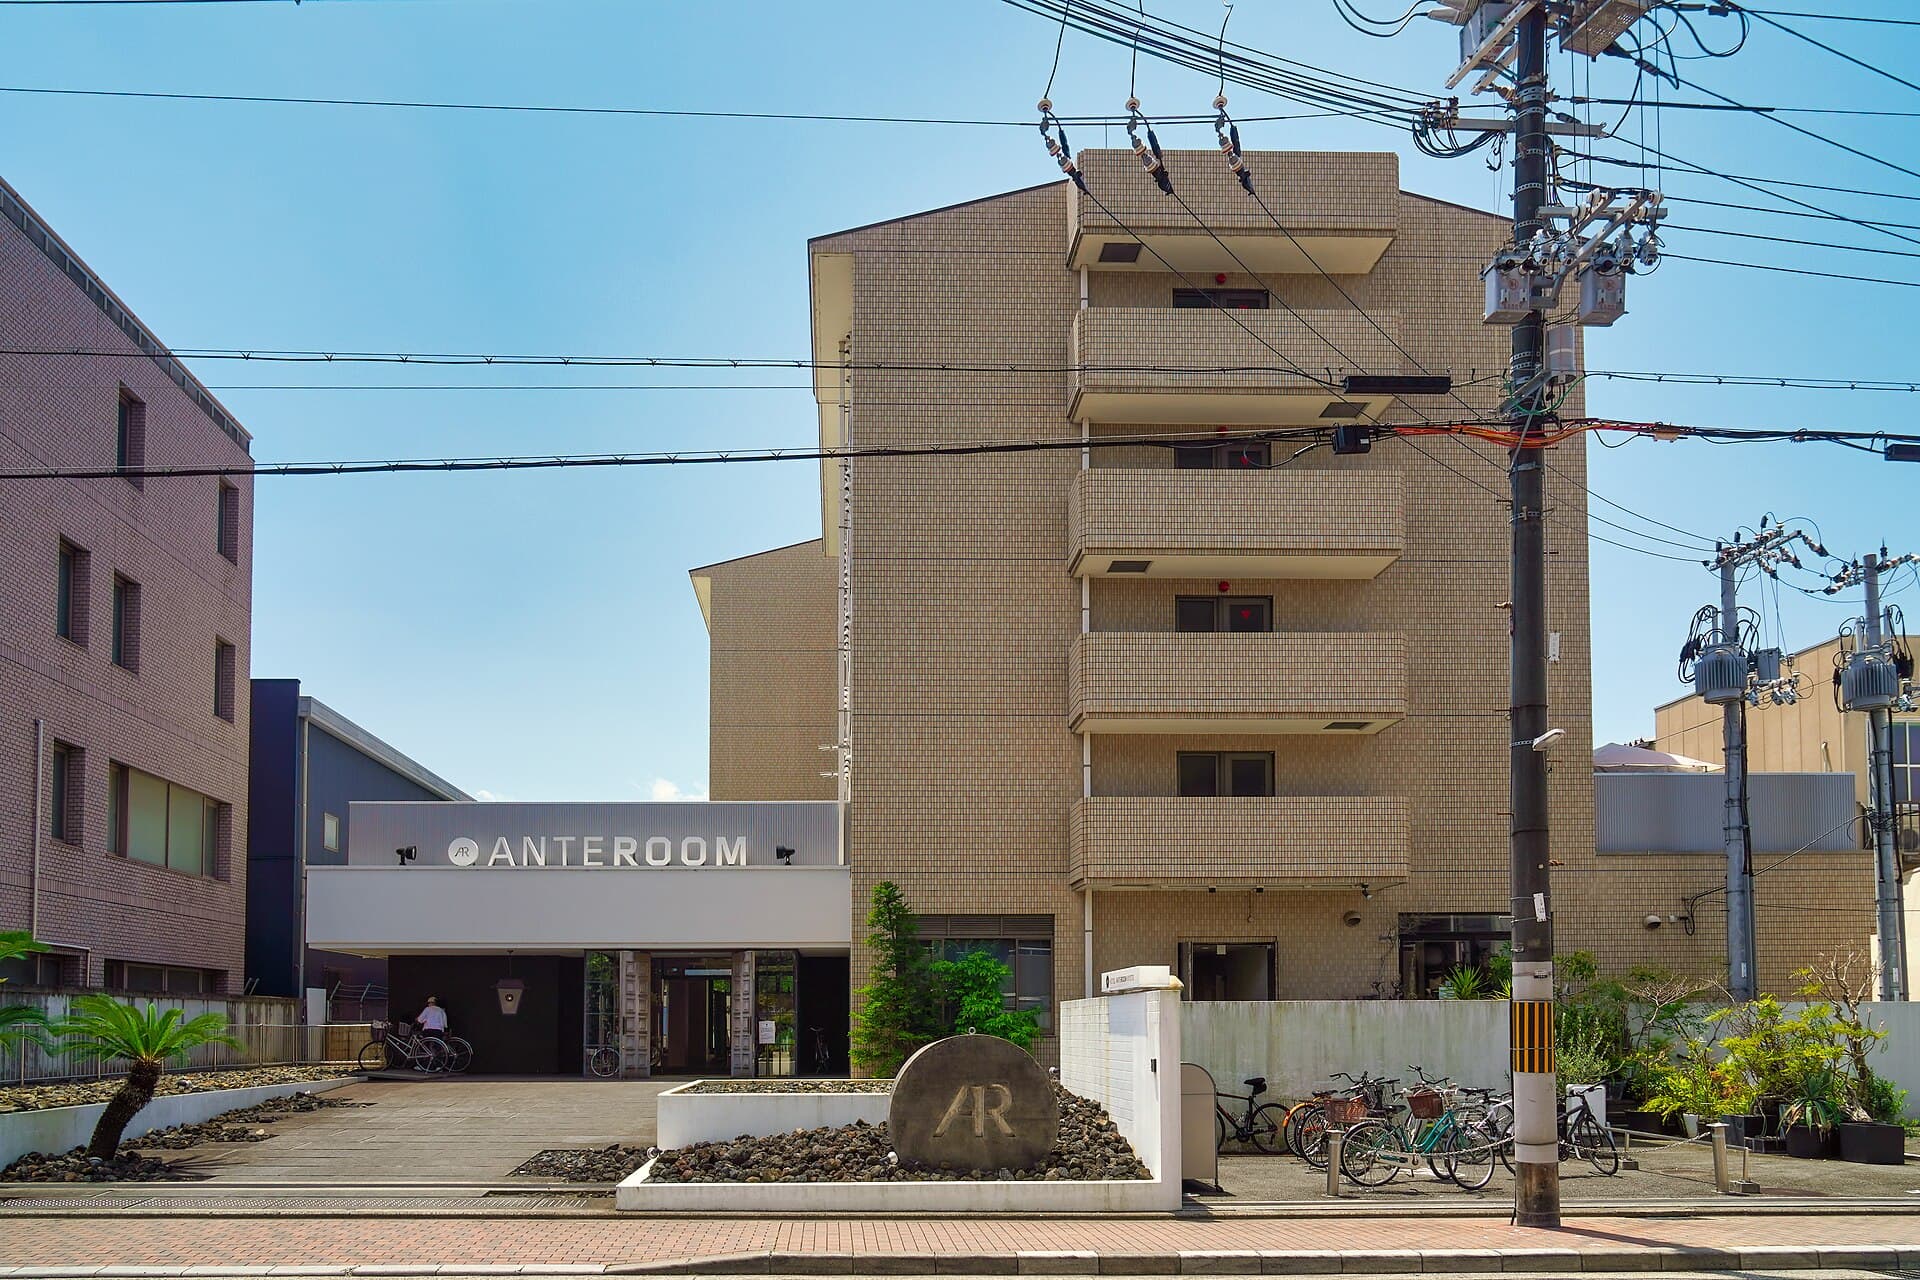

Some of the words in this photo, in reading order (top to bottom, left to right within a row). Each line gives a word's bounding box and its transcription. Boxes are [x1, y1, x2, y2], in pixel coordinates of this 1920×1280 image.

[454, 846, 470, 857] AR
[487, 836, 747, 866] ANTEROOM
[932, 1083, 1017, 1138] AR
